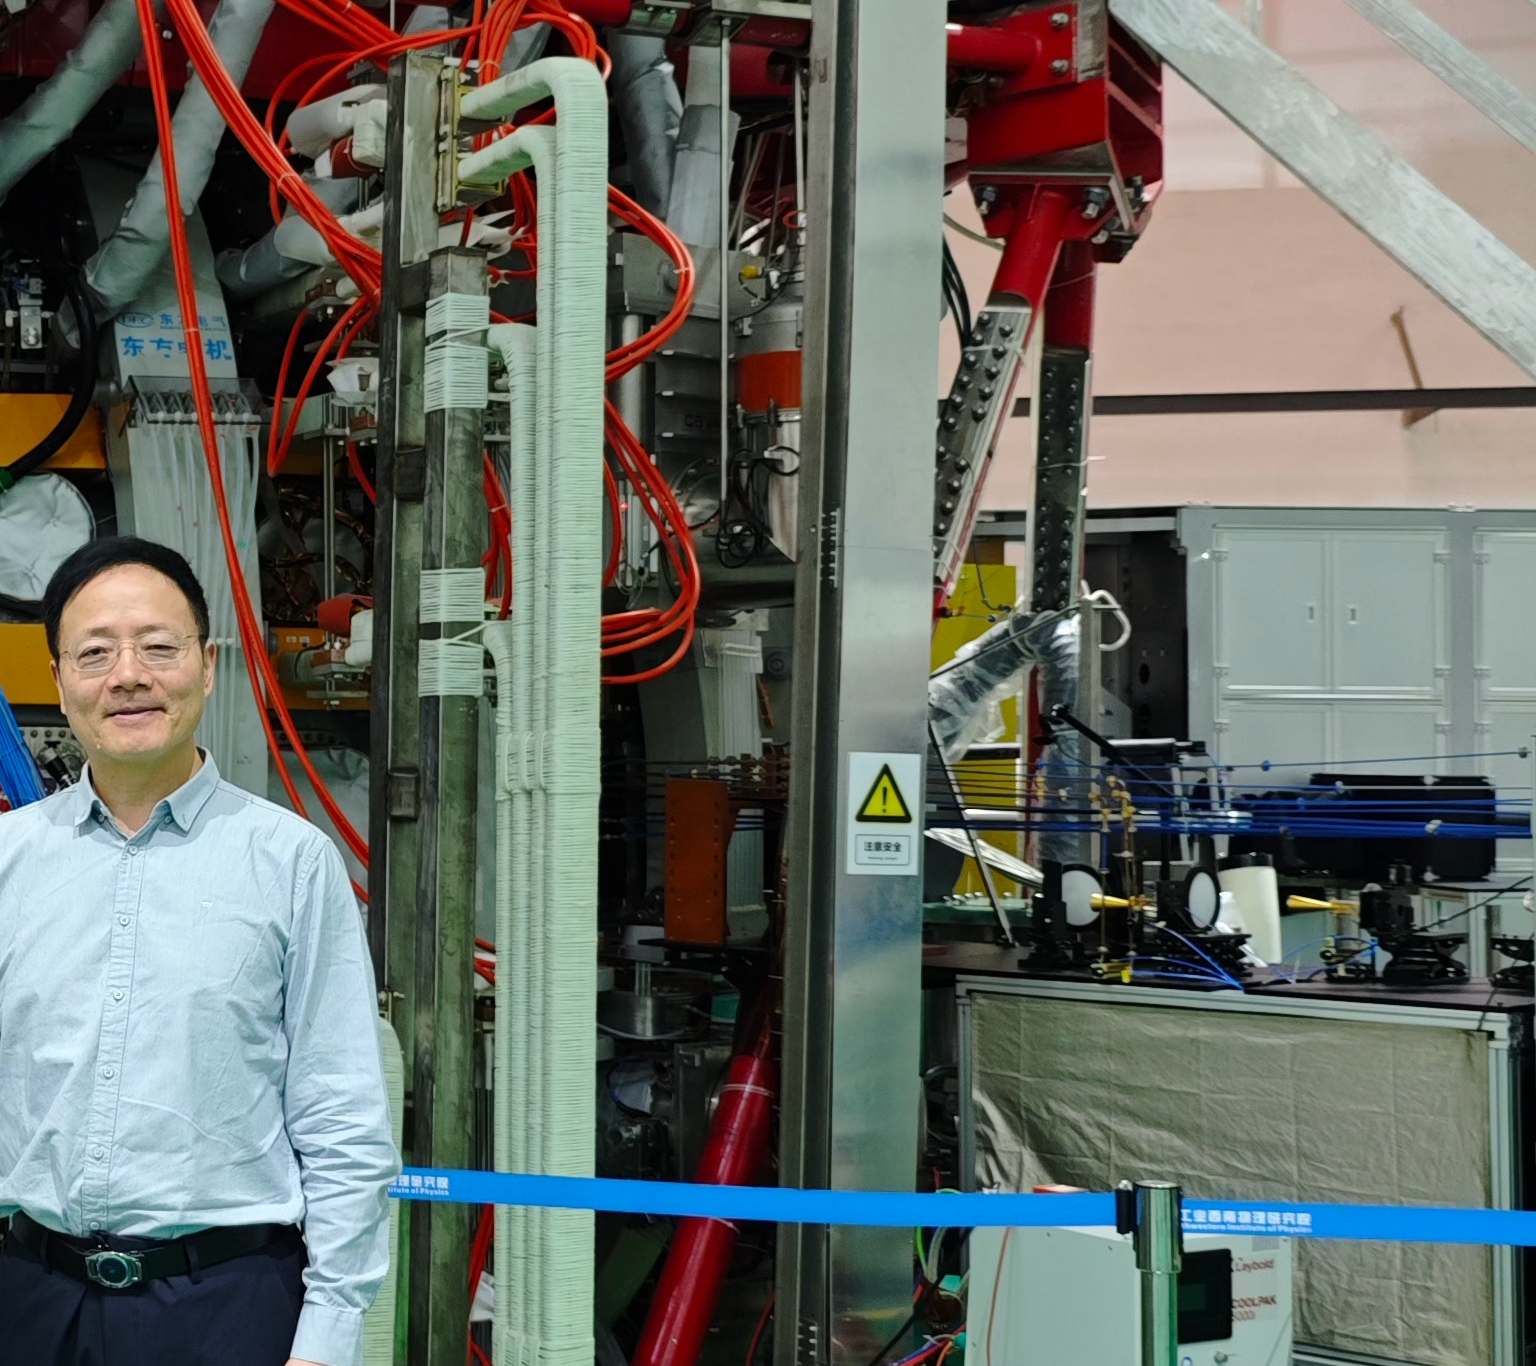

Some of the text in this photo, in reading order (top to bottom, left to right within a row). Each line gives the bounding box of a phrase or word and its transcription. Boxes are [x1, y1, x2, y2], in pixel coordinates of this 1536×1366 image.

[863, 841, 902, 852] 注意安全
[391, 1174, 449, 1189] 理研究院
[1235, 1258, 1275, 1274] Leybold
